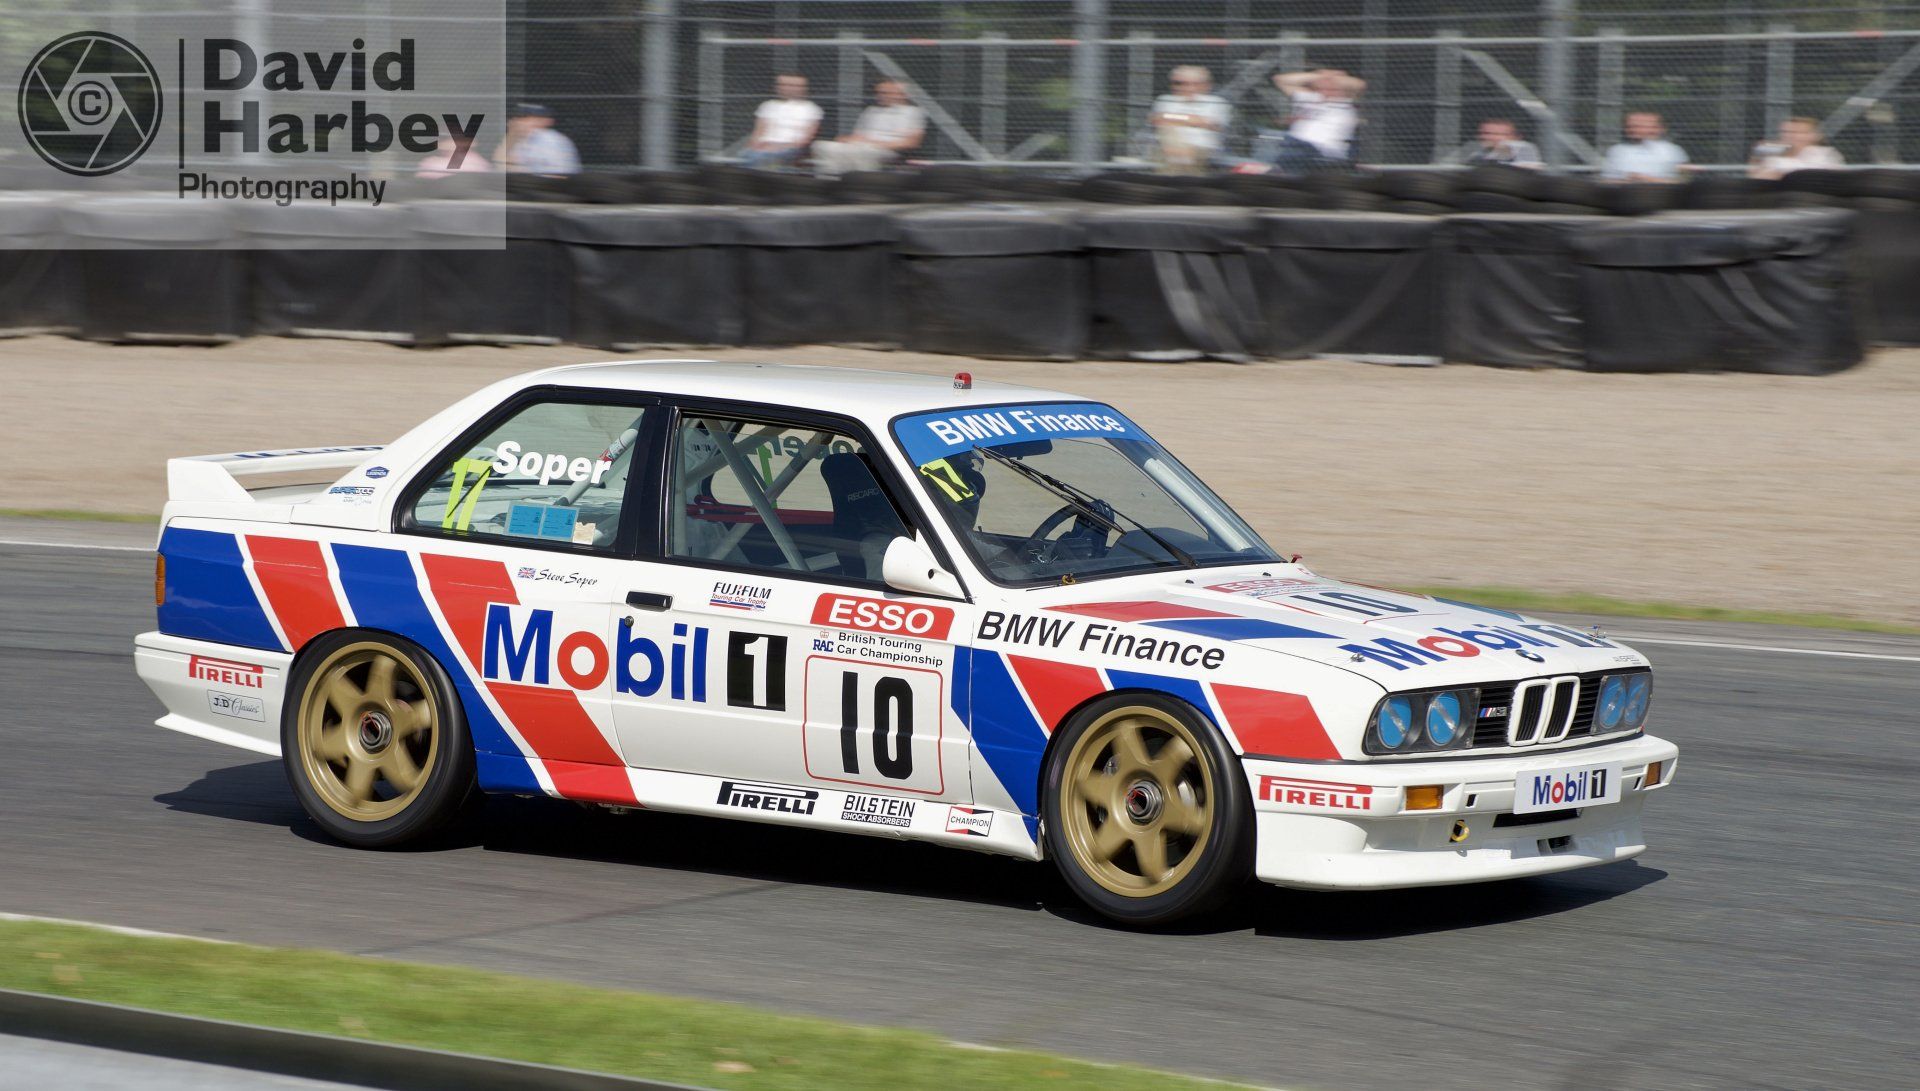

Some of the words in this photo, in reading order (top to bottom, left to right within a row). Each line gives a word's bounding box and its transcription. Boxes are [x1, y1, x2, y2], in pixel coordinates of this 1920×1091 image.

[926, 412, 1018, 446] BMW
[1009, 410, 1126, 433] Finance
[492, 441, 613, 486] Soper
[441, 458, 492, 532] 17
[535, 569, 564, 581] Steve
[564, 572, 598, 588] Soper
[713, 582, 772, 599] FUJIFILM
[829, 598, 935, 634] ESSO
[1289, 592, 1419, 616] 10
[483, 604, 709, 703] Mobil
[813, 639, 834, 652] RAC
[837, 644, 857, 654] Car
[860, 647, 943, 667] Championship
[838, 632, 876, 645] British
[879, 637, 922, 652] Touring
[977, 611, 1075, 647] BMW
[1079, 623, 1225, 670] Finance
[1337, 624, 1559, 670] Mobil
[189, 654, 264, 688] PIRELLI
[841, 671, 913, 780] 10
[717, 781, 819, 815] PIRELLI
[1259, 775, 1373, 810] PIRELLI
[1533, 771, 1587, 805] Mobil
[842, 812, 867, 822] SHOCK
[867, 815, 910, 827] ABSORBERS
[844, 795, 915, 817] BILSTEIN
[951, 815, 990, 828] CHAMPION
